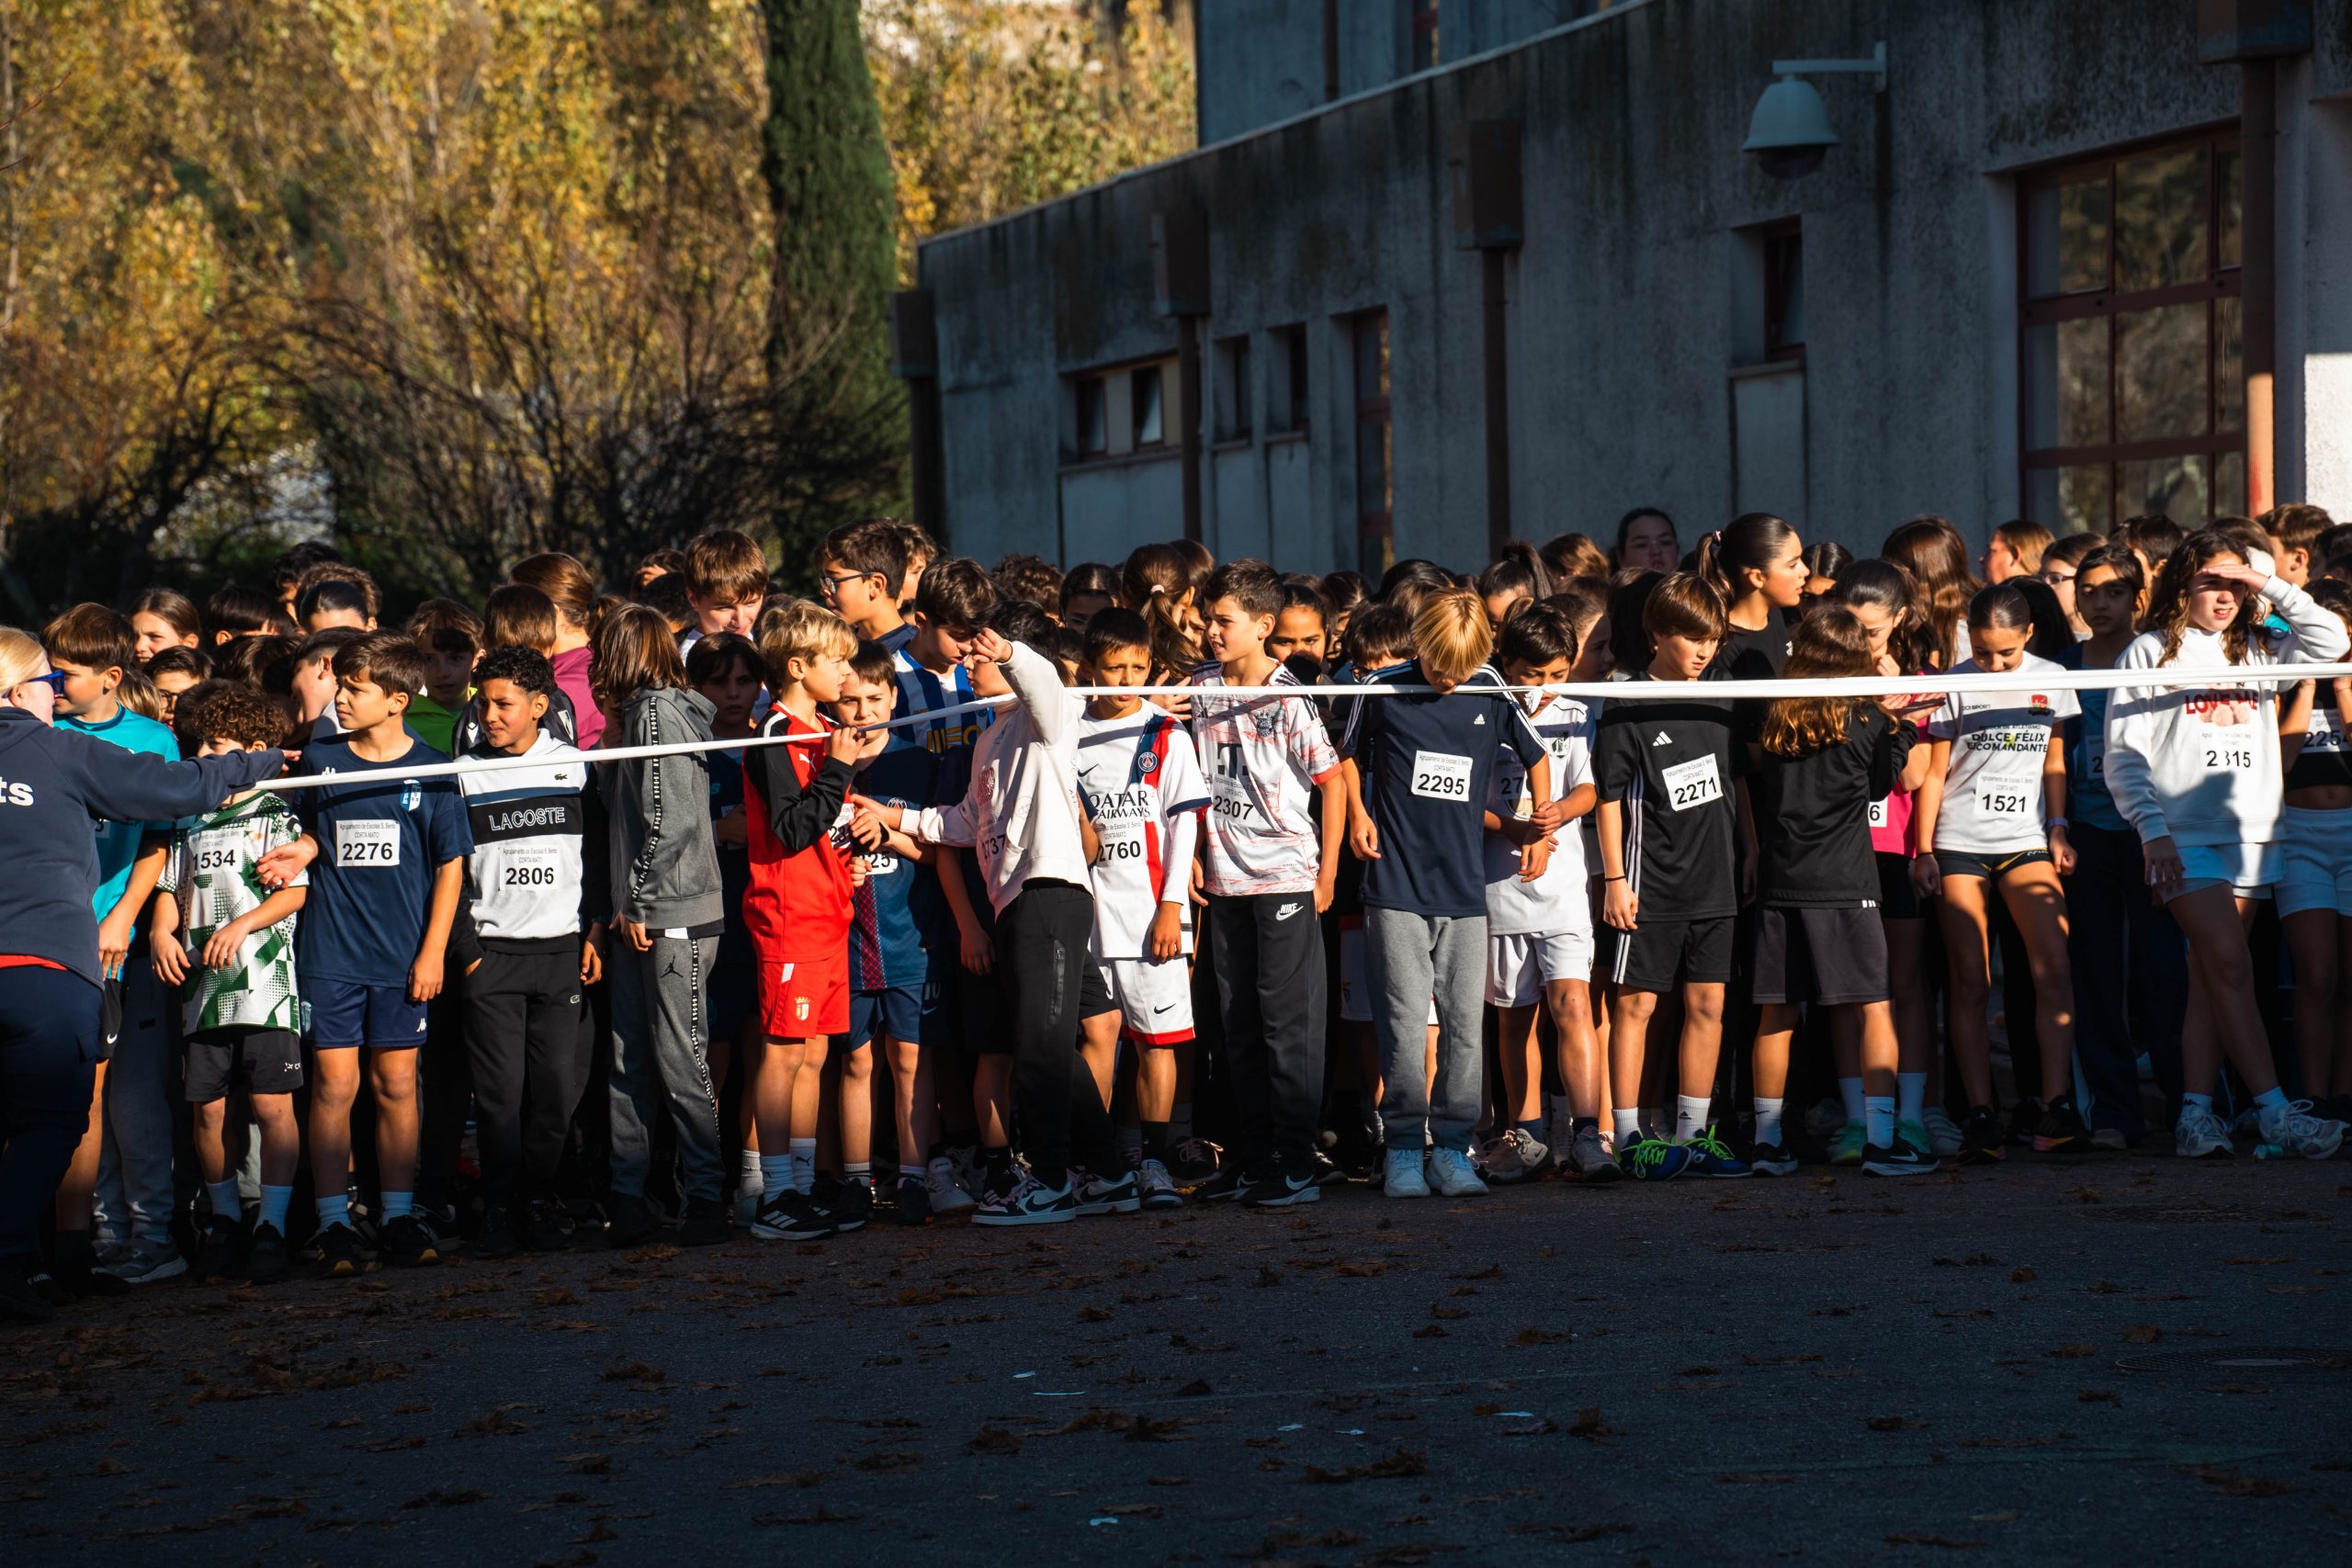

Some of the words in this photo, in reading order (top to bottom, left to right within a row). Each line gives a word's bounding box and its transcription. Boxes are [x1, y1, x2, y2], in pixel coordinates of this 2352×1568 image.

[2185, 693, 2230, 715] LOVE
[1972, 732, 2010, 742] DULCE
[2014, 729, 2045, 742] FÉLIX
[1418, 773, 1465, 795] 2295
[1675, 776, 1717, 805] 2271
[1098, 807, 1150, 819] AIRWAYS
[1213, 795, 1254, 820] 2307
[1983, 794, 2026, 813] 1521
[489, 807, 566, 831] LACOSTE
[193, 849, 236, 870] 1534
[343, 842, 393, 861] 2276
[1098, 840, 1141, 862] 2760
[505, 867, 554, 886] 2806
[1280, 902, 1298, 914] NIKE
